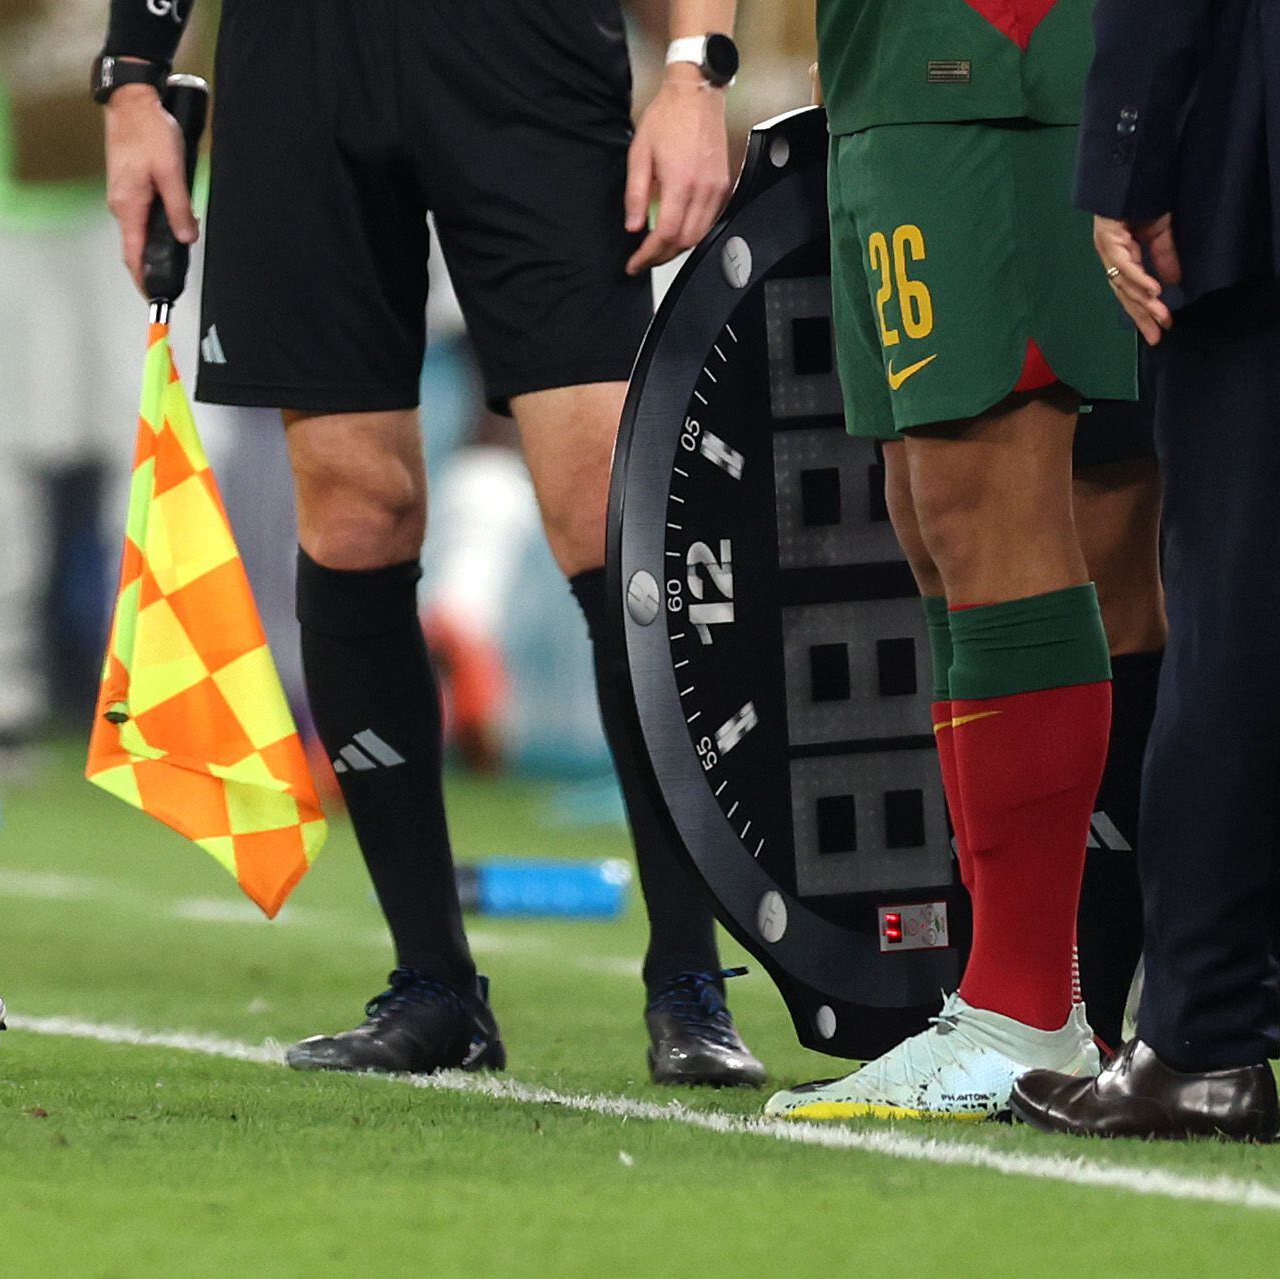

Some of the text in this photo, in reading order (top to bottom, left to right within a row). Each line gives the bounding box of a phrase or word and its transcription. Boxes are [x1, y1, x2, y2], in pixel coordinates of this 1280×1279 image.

[869, 224, 933, 347] 26
[681, 416, 700, 452] 05
[667, 579, 682, 612] 60
[686, 539, 735, 645] 12
[696, 735, 718, 771] 55
[941, 1093, 991, 1101] PHANTOM
